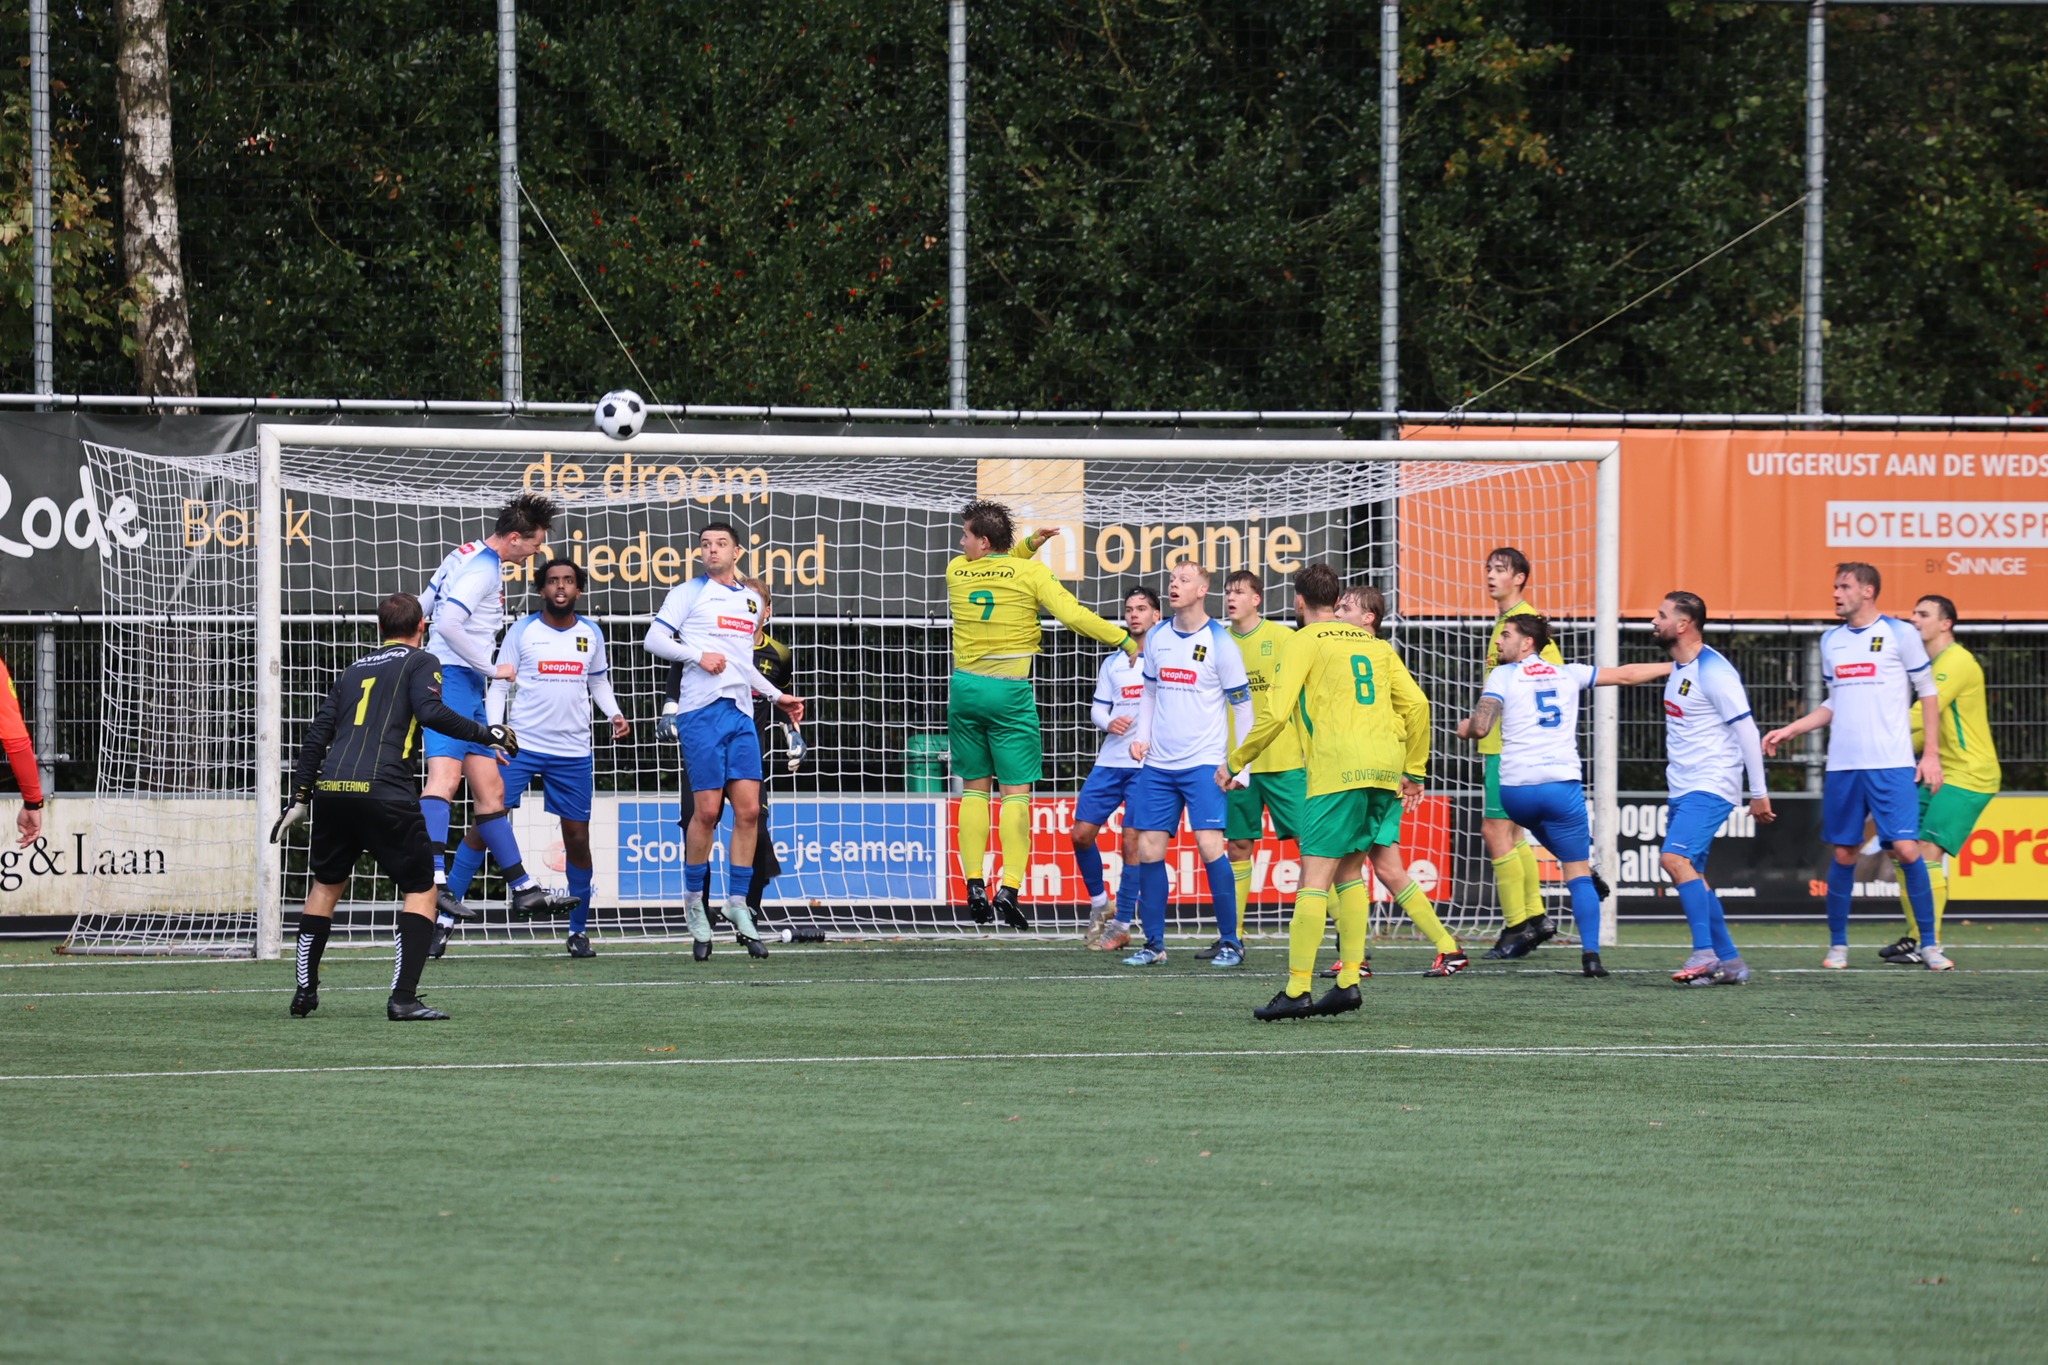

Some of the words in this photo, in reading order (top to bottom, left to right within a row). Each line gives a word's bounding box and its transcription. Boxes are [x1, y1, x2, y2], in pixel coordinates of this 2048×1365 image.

[522, 452, 585, 500] de
[603, 453, 769, 504] droom
[1748, 453, 1881, 476] UITGERUST
[1885, 454, 1937, 477] AAN
[1944, 454, 1976, 477] DE
[183, 499, 310, 547] Bak
[573, 529, 703, 584] ieder
[1926, 559, 1944, 573] BY
[954, 570, 1014, 579] OLYMPIA
[968, 590, 995, 621] 9
[721, 616, 753, 631] beaphar
[542, 662, 581, 673] beaphar
[1161, 669, 1194, 681] beaphar
[1350, 654, 1375, 705] 8
[354, 677, 377, 726] 1
[1534, 687, 1562, 729] 5
[1341, 770, 1353, 783] SC
[72, 832, 167, 876] Laan
[626, 834, 725, 863] Scorn
[794, 834, 822, 870] je
[830, 838, 933, 863] samen.
